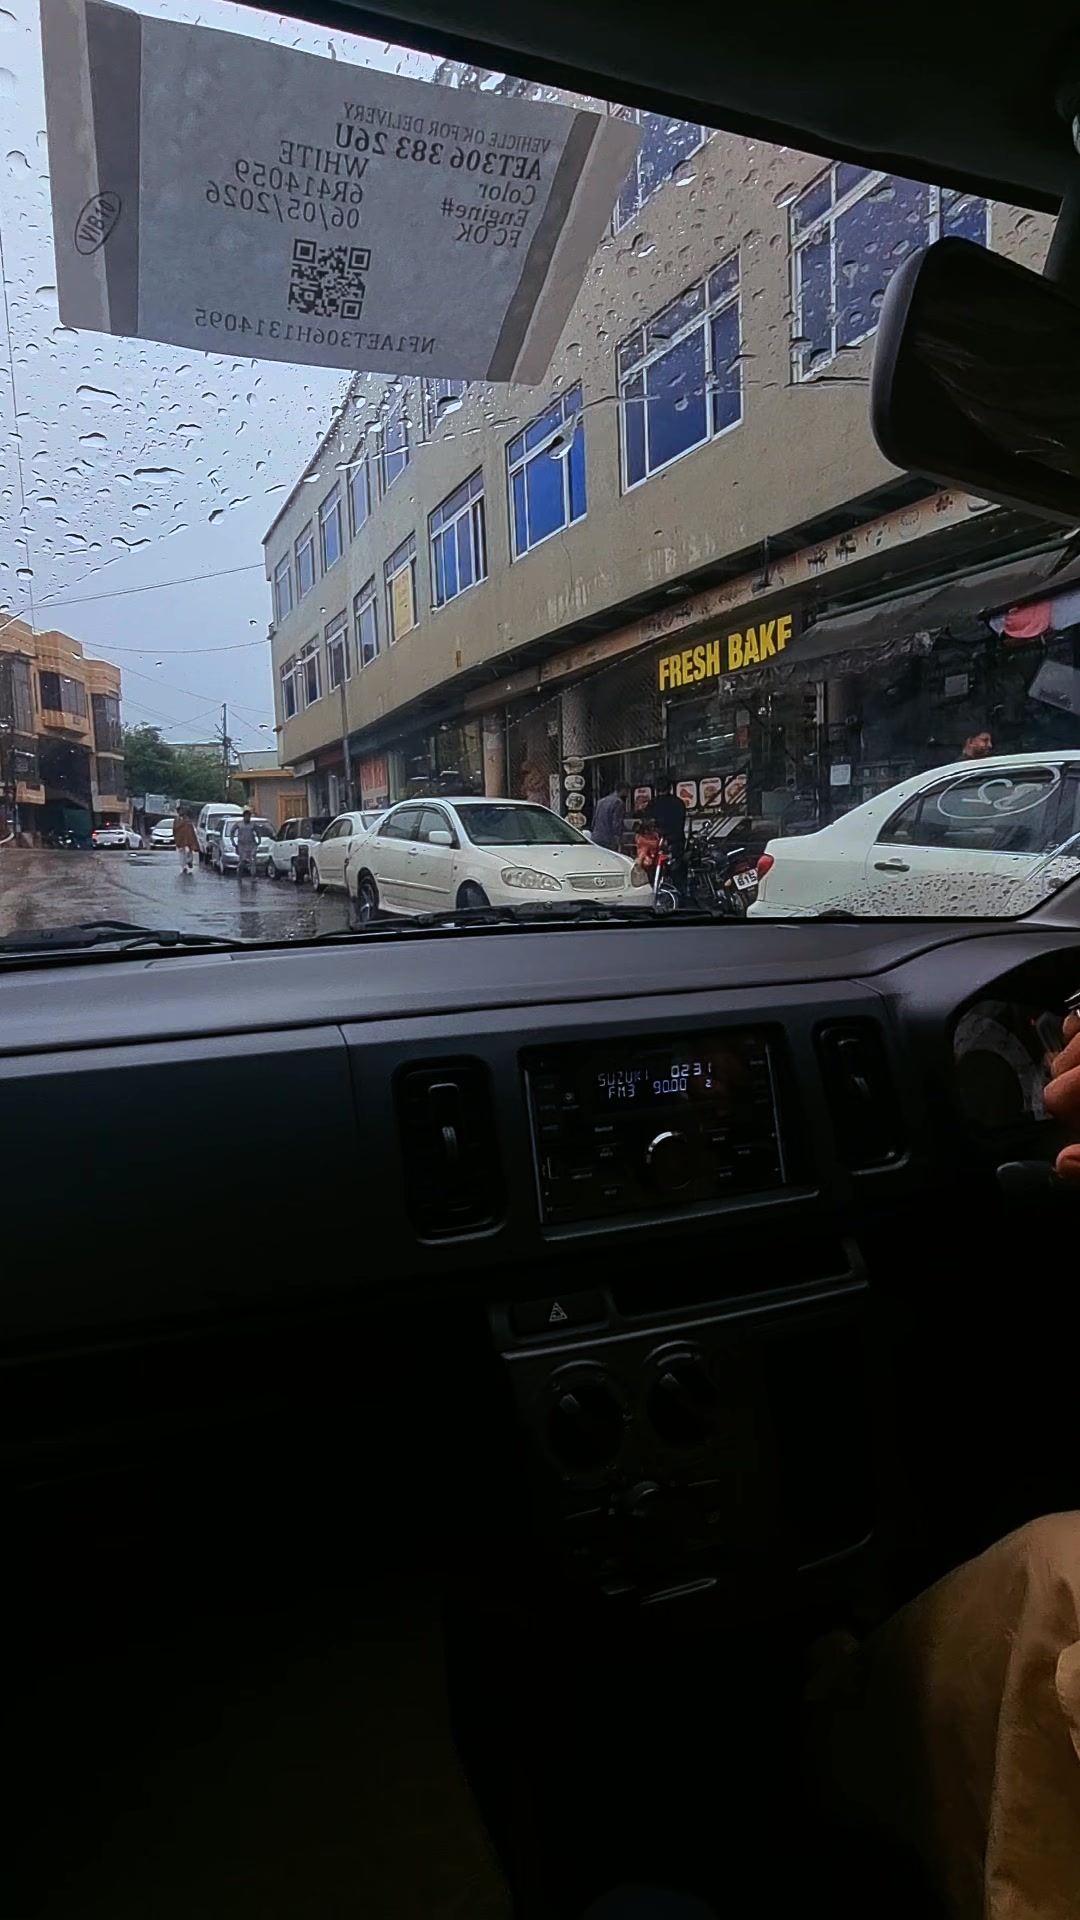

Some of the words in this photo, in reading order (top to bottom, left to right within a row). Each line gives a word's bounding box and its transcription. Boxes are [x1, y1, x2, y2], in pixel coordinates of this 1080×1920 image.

[659, 640, 720, 691] FRESH
[597, 1068, 649, 1087] SUZUKI
[608, 1084, 635, 1099] FM3
